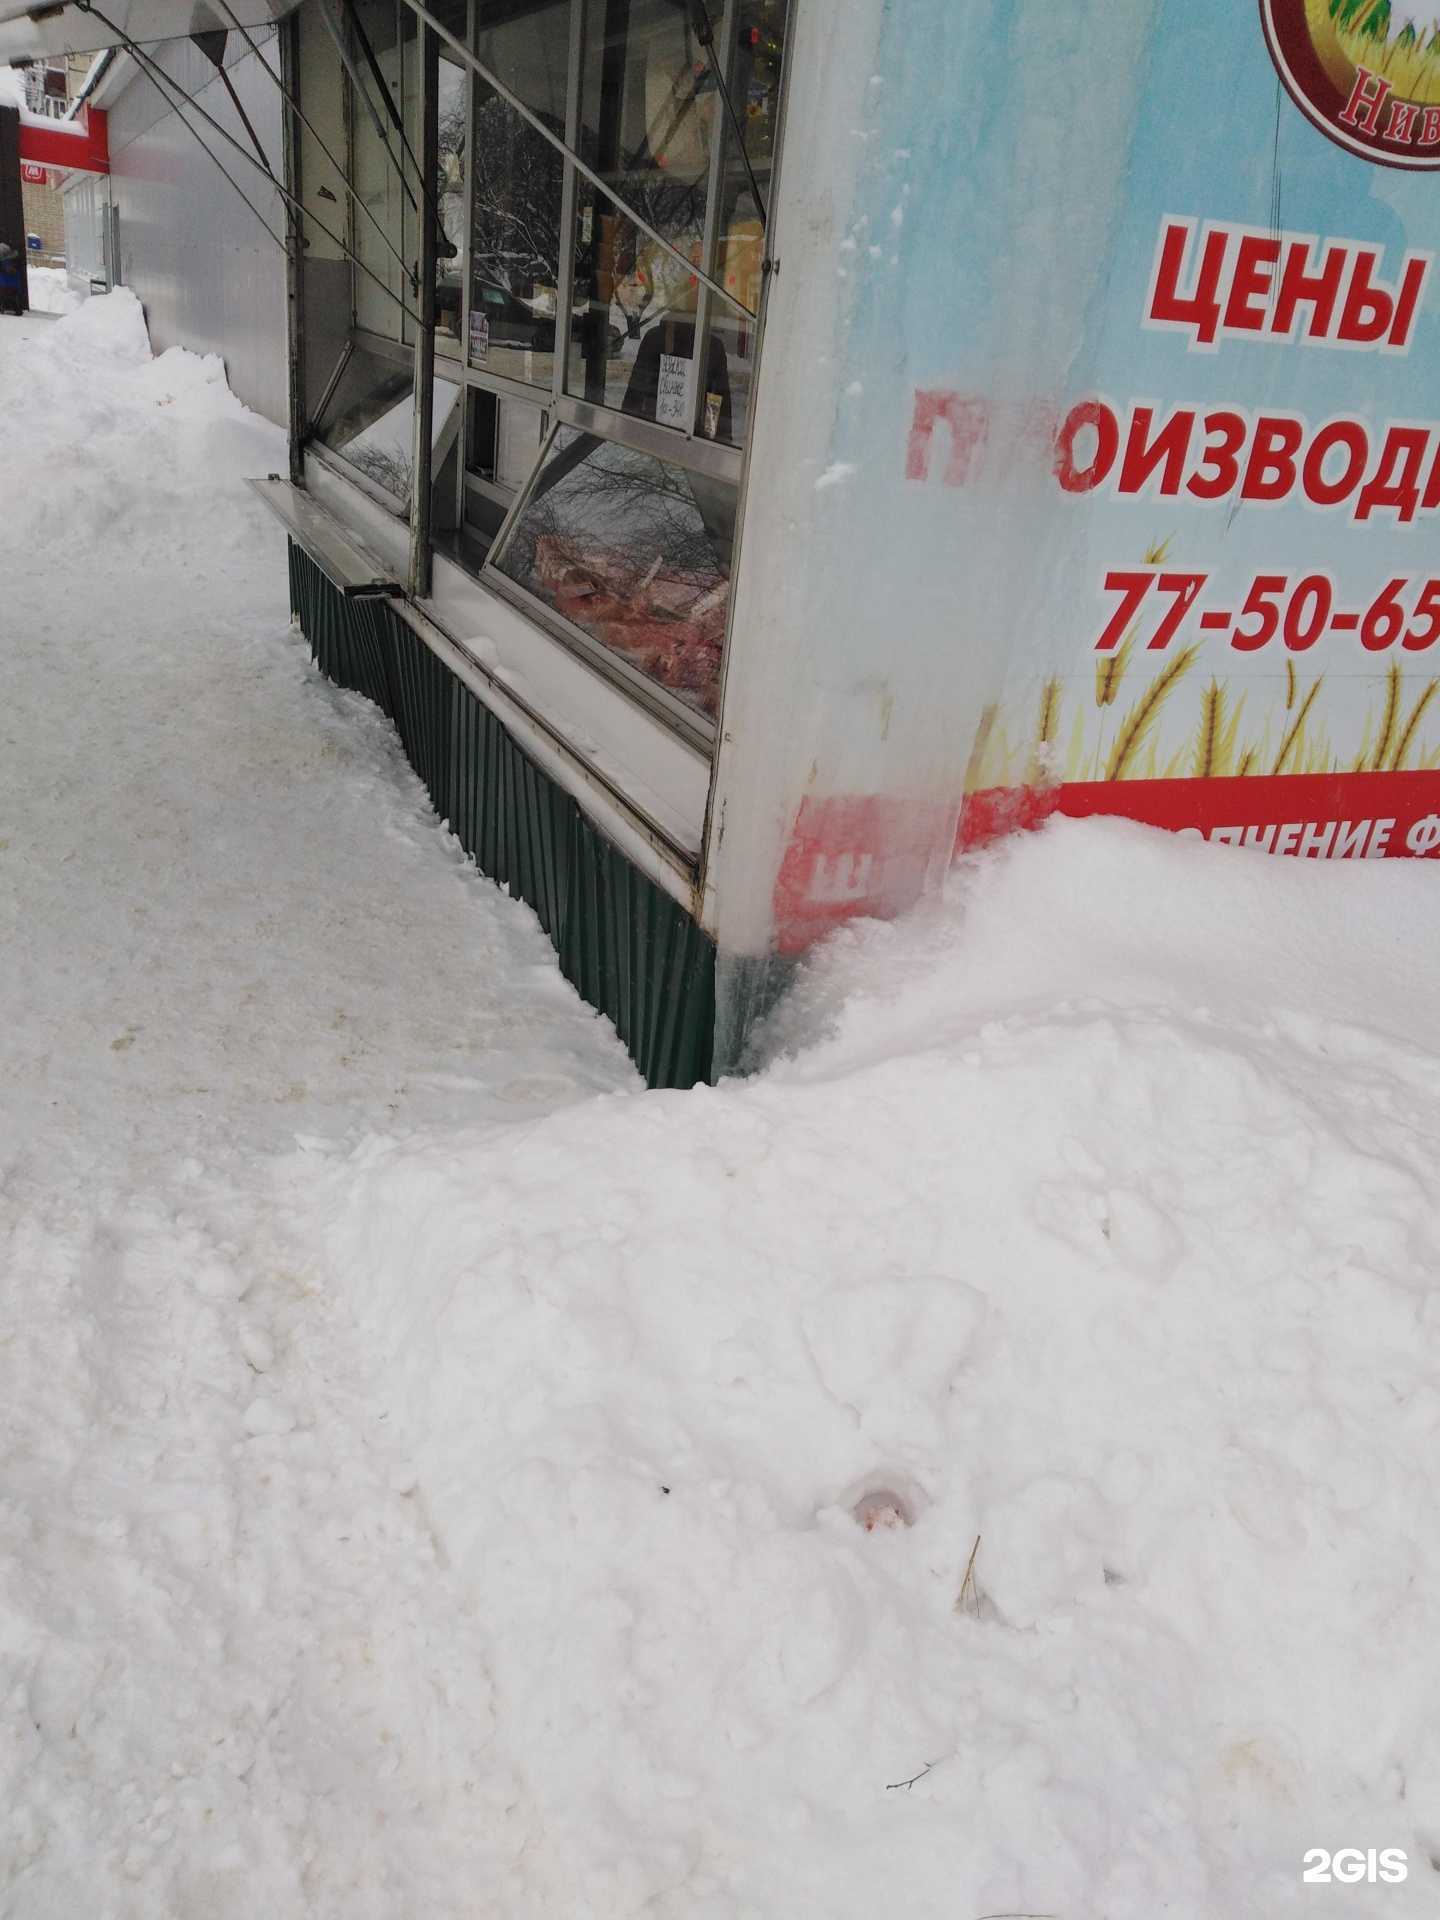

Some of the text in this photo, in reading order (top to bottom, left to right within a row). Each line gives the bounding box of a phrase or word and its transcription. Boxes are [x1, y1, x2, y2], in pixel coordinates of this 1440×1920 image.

[1146, 220, 1430, 348] ЦЕНЫ
[904, 388, 1440, 522] ПОИЗВОД
[1093, 571, 1440, 652] 77-50-65
